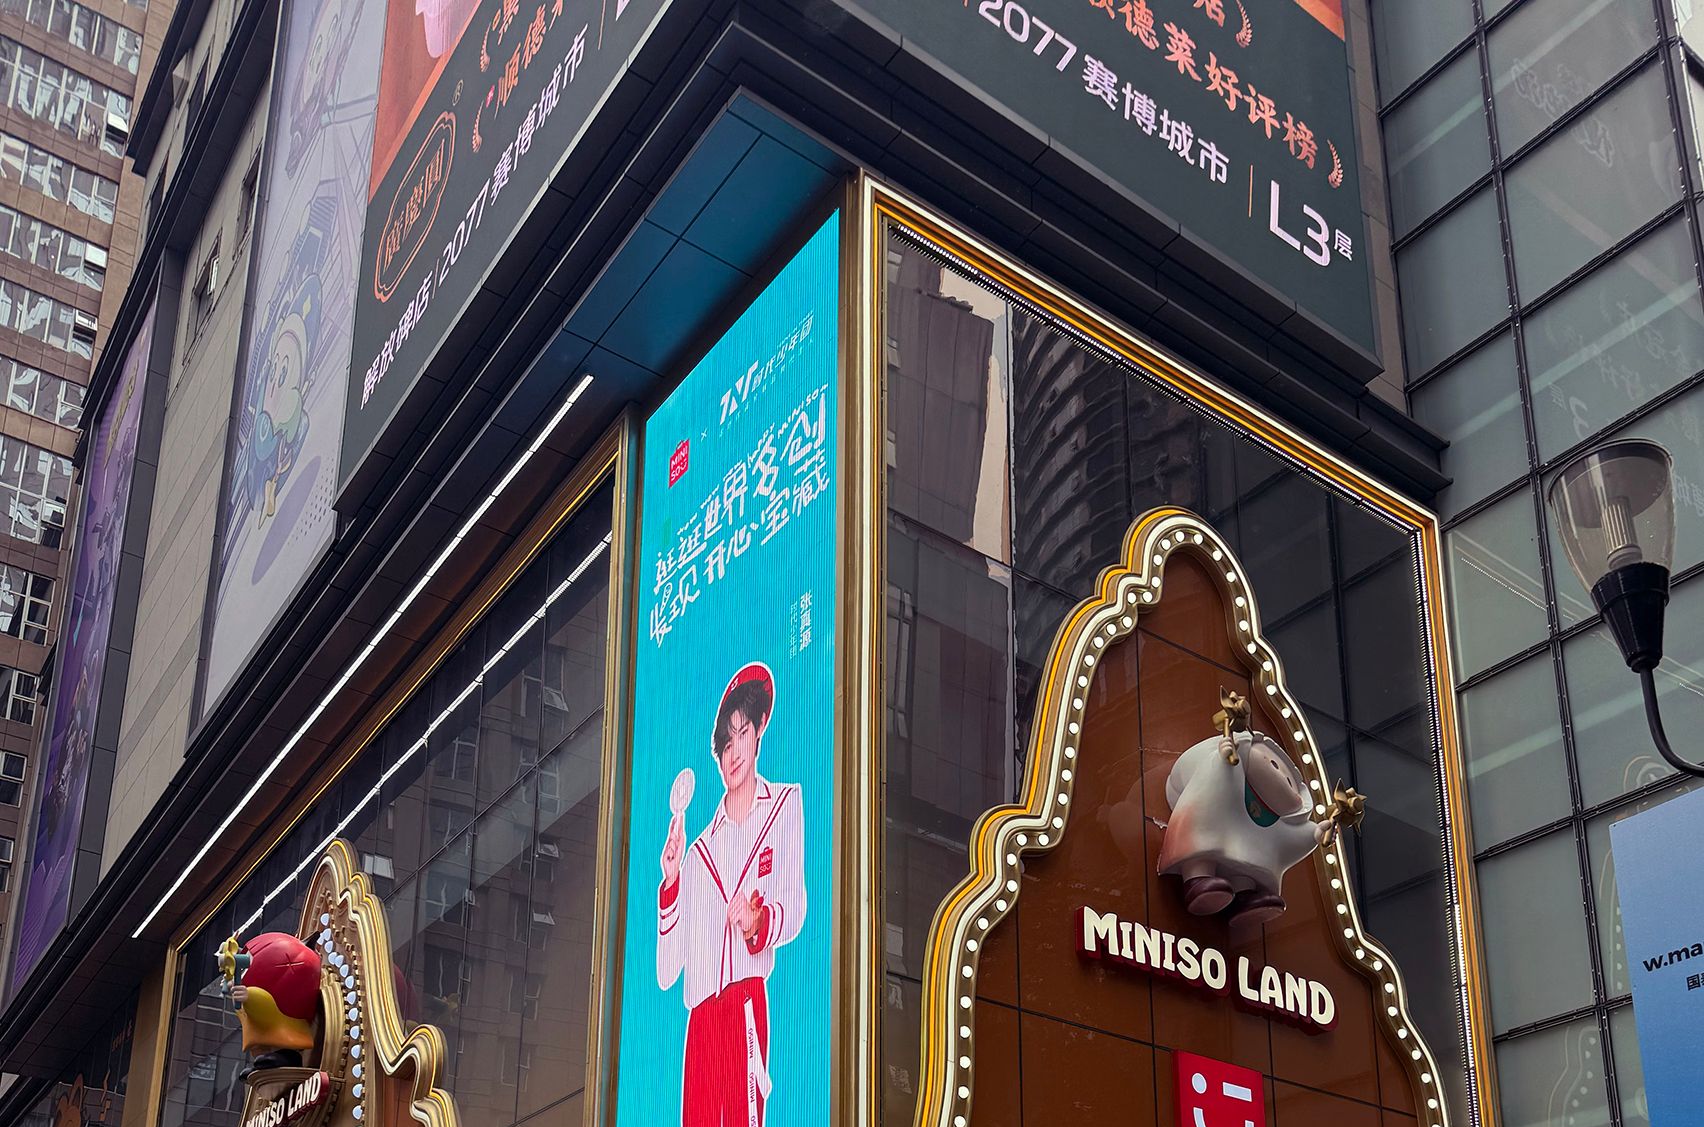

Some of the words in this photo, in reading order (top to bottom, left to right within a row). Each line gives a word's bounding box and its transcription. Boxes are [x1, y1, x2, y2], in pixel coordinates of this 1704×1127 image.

[979, 0, 1077, 72] 2077
[1081, 54, 1230, 184] 赛博城市
[438, 178, 491, 287] 2077
[670, 445, 689, 470] MINI
[1082, 905, 1228, 990] MINISO
[1237, 956, 1335, 1026] LAND
[1643, 942, 1704, 972] w.ma
[1686, 972, 1704, 991] 国
[287, 1072, 321, 1117] LAND
